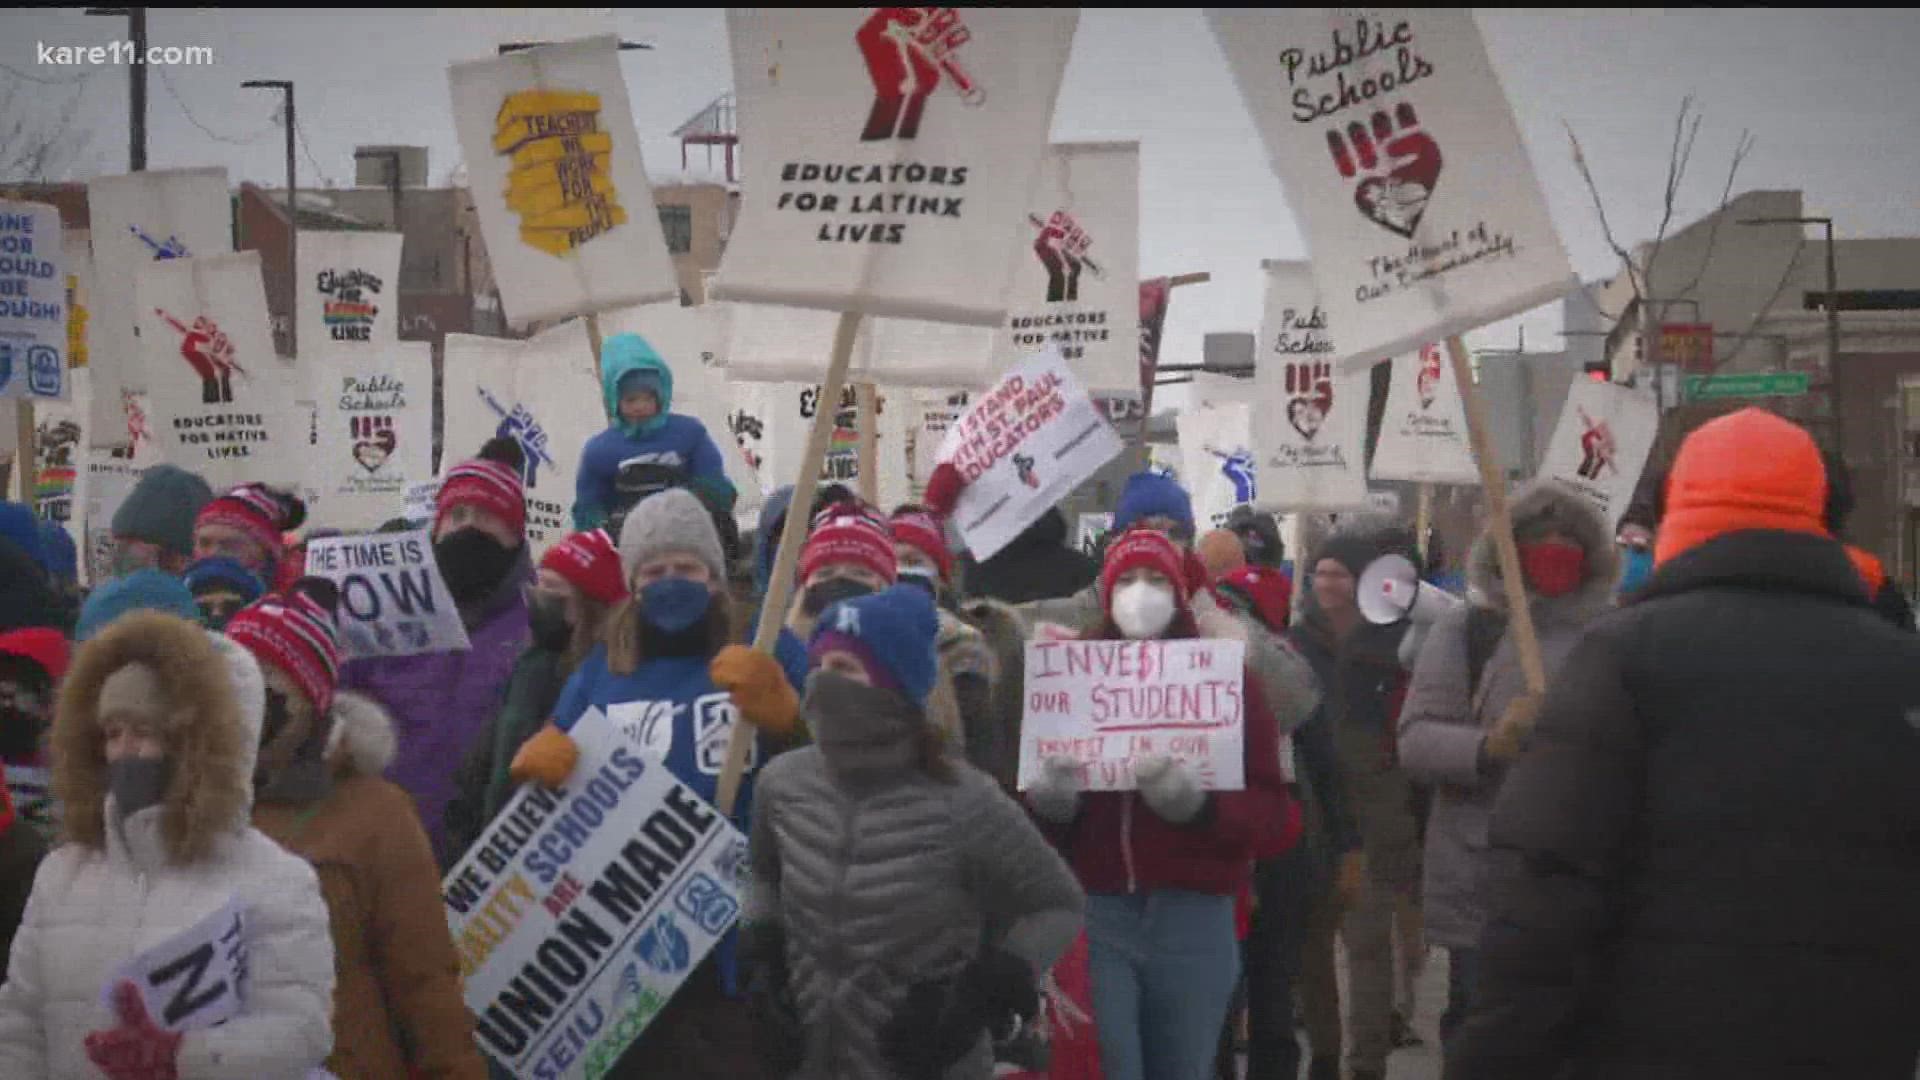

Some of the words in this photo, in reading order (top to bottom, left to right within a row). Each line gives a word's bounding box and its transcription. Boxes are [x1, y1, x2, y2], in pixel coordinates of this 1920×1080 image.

[1280, 19, 1413, 84] Public
[1292, 47, 1434, 123] Schools
[781, 162, 968, 187] EDUCATORS
[777, 192, 839, 212] FOR
[849, 194, 964, 218] LATINX
[817, 223, 906, 245] LIVES
[0, 257, 55, 279] OULD
[0, 301, 60, 321] OUGH!
[1011, 312, 1107, 329] EDUCATORS
[173, 413, 263, 429] EDUCATORS
[179, 432, 209, 443] FOR
[341, 543, 396, 569] TIME
[401, 540, 424, 564] IS
[341, 568, 436, 622] OW
[1030, 691, 1071, 714] OUR
[1090, 679, 1241, 725] STUDENTS
[459, 870, 537, 978] ALITY
[522, 747, 646, 884] SCHOOLS
[448, 861, 493, 915] WE
[476, 906, 614, 1057] UNION
[588, 784, 717, 926] MADE
